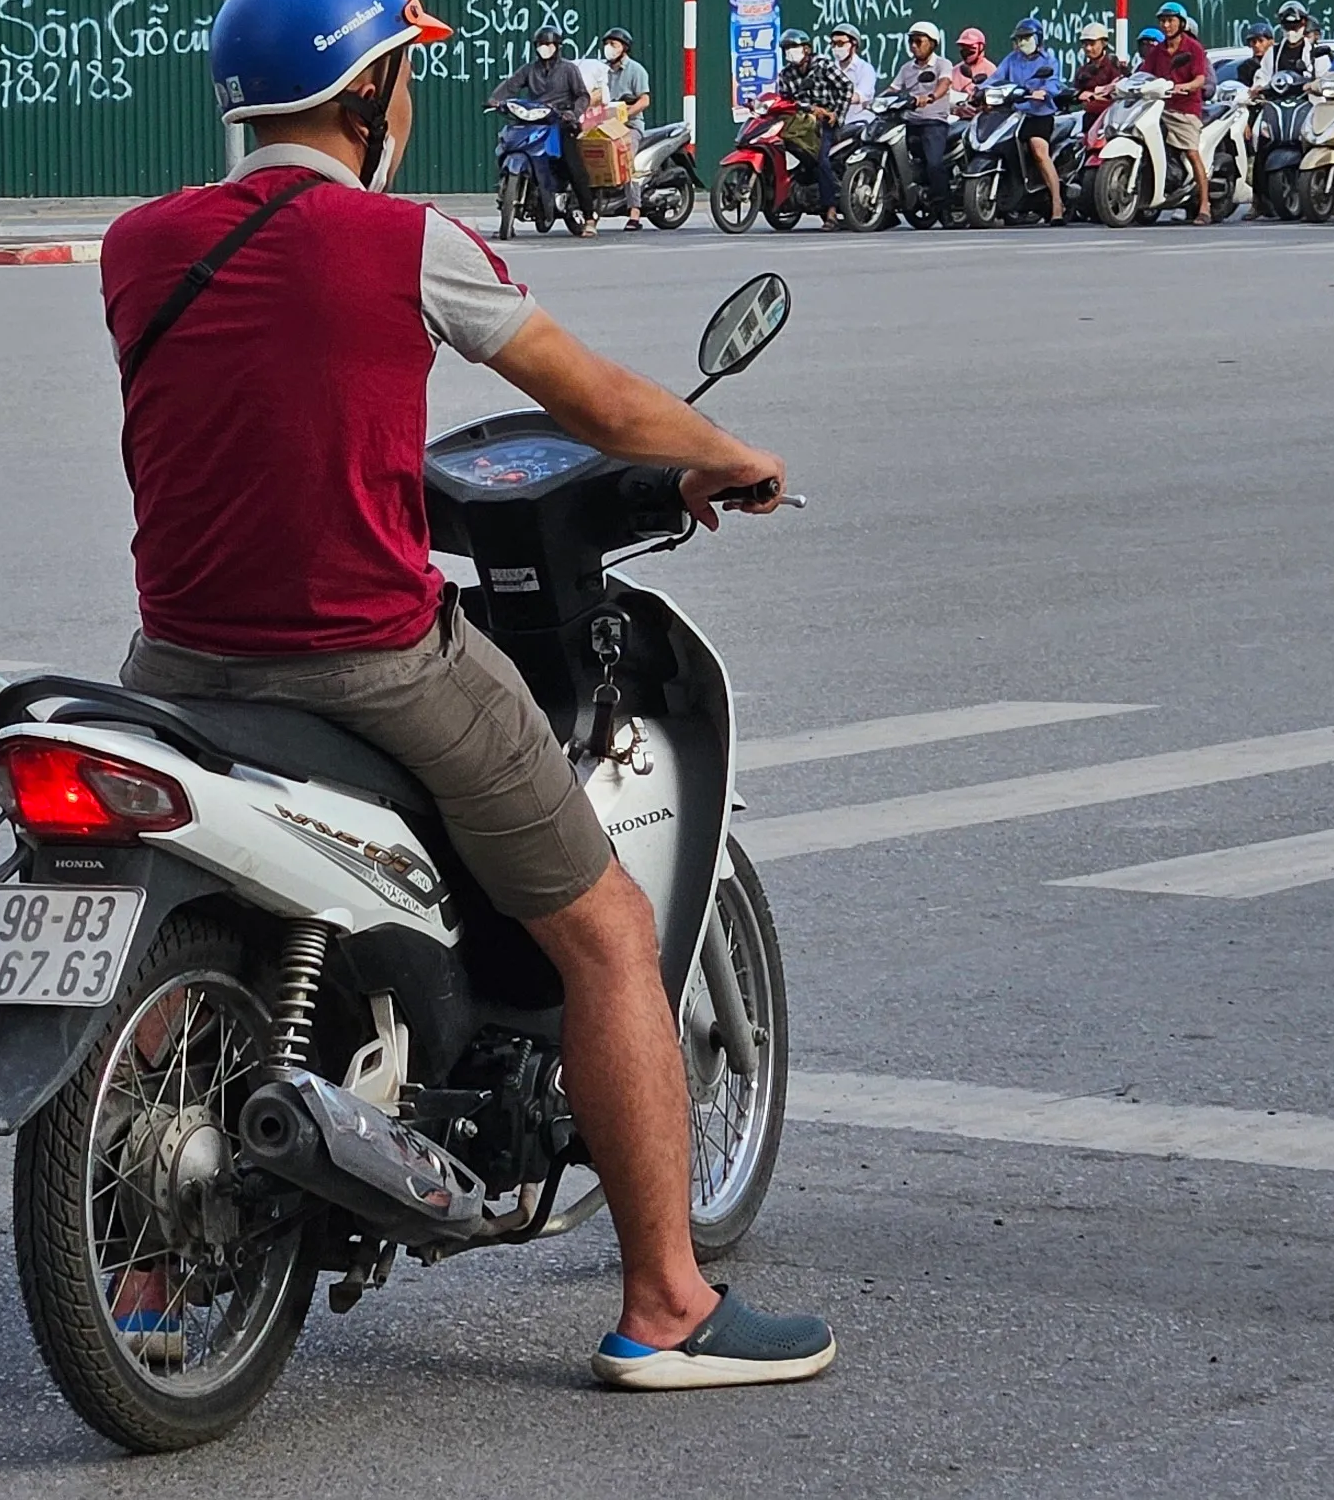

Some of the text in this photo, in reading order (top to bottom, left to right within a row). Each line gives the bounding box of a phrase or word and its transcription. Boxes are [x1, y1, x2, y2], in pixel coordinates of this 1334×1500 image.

[313, 0, 385, 52] Sacombank
[607, 808, 675, 836] HONDA
[55, 859, 105, 870] HONDA
